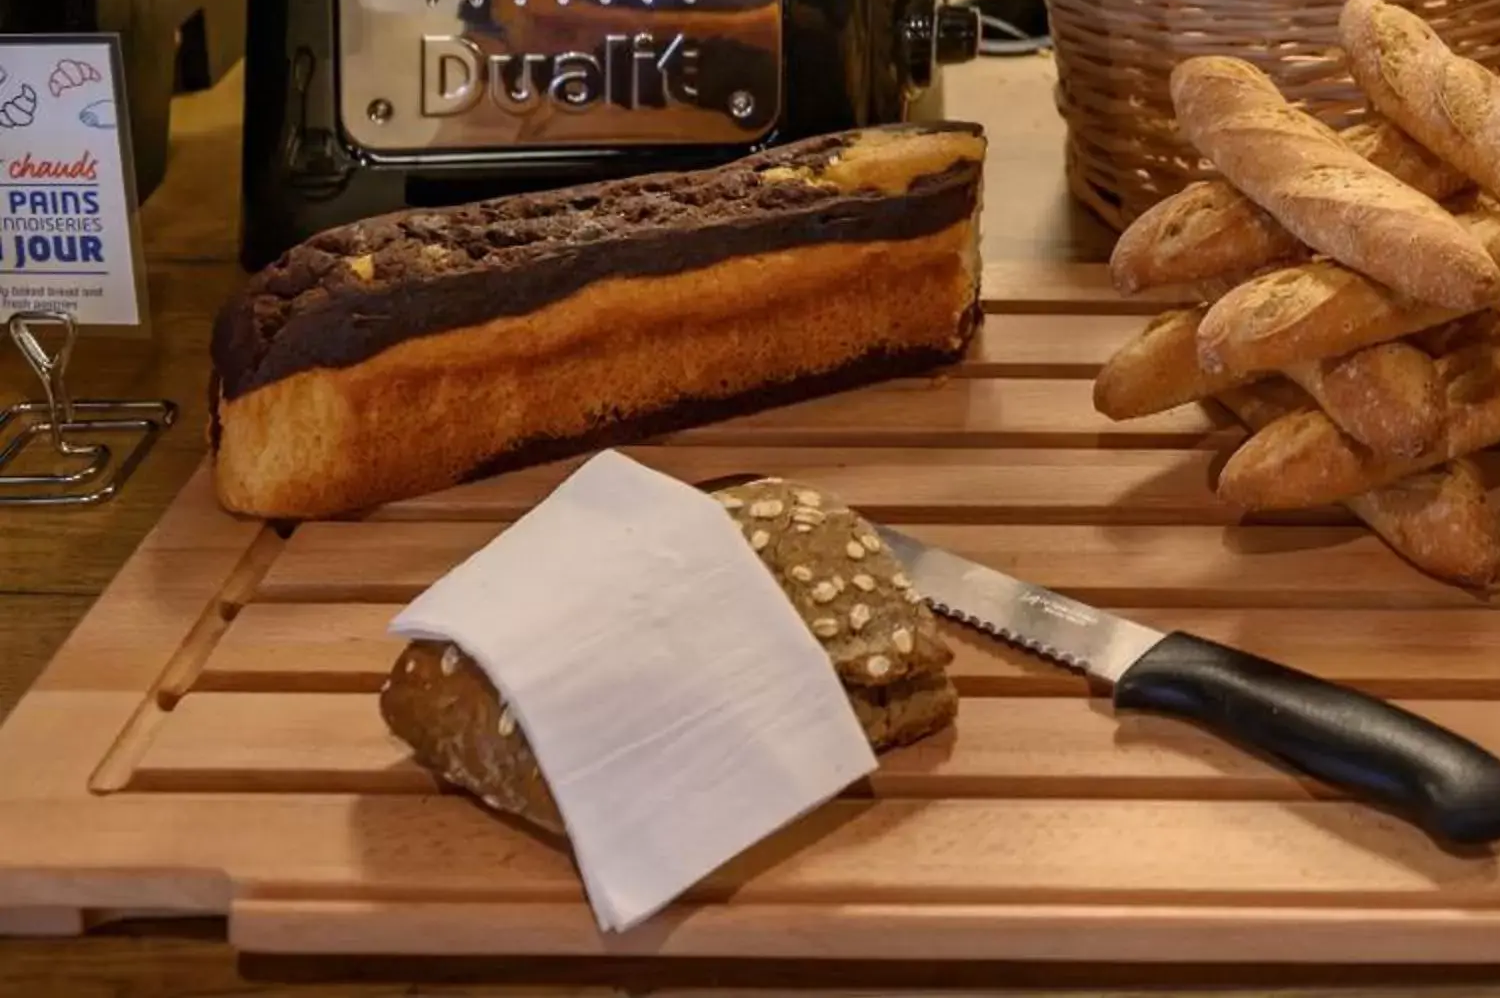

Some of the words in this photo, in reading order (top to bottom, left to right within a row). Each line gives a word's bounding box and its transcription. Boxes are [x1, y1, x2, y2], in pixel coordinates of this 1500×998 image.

[420, 33, 699, 117] Dualit
[9, 149, 99, 180] chauds
[9, 190, 100, 215] PAINS
[0, 217, 103, 233] NNOISERIES
[14, 235, 105, 269] JOUR
